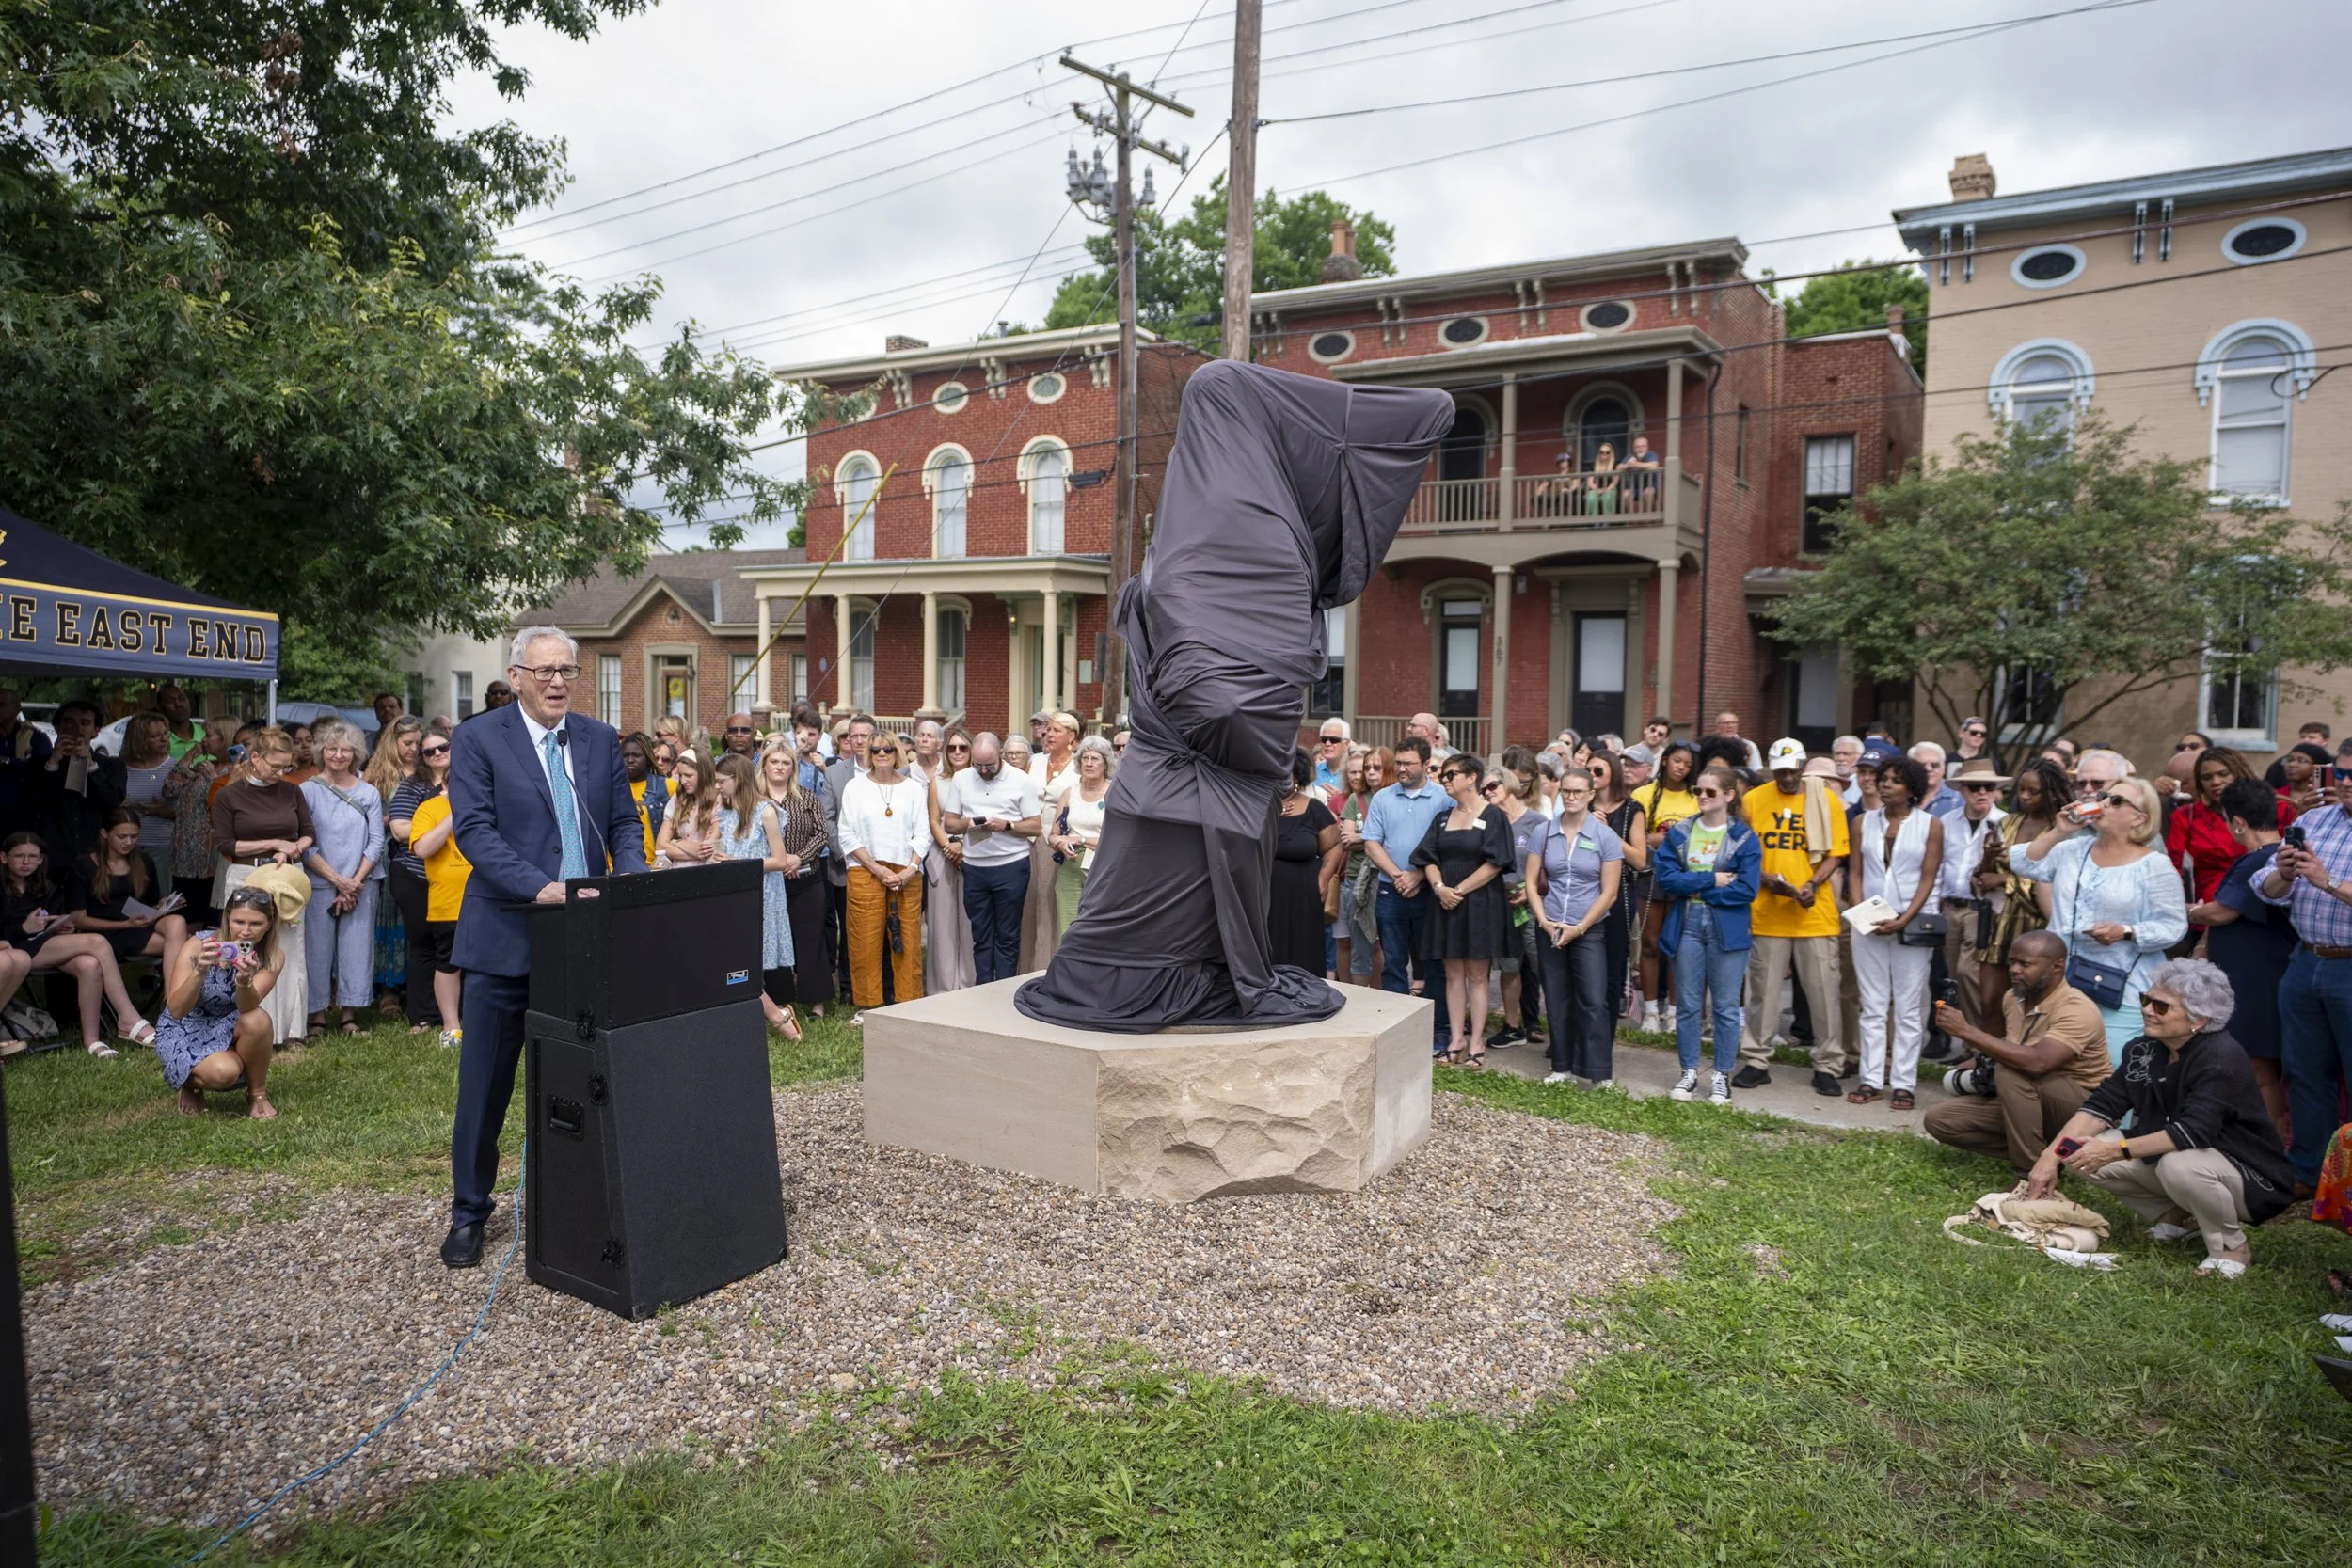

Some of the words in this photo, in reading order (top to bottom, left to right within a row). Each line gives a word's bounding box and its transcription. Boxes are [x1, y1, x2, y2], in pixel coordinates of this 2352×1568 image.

[0, 594, 37, 642] E
[56, 601, 172, 655] EAST
[187, 618, 266, 664] END
[1772, 811, 1806, 832] YE
